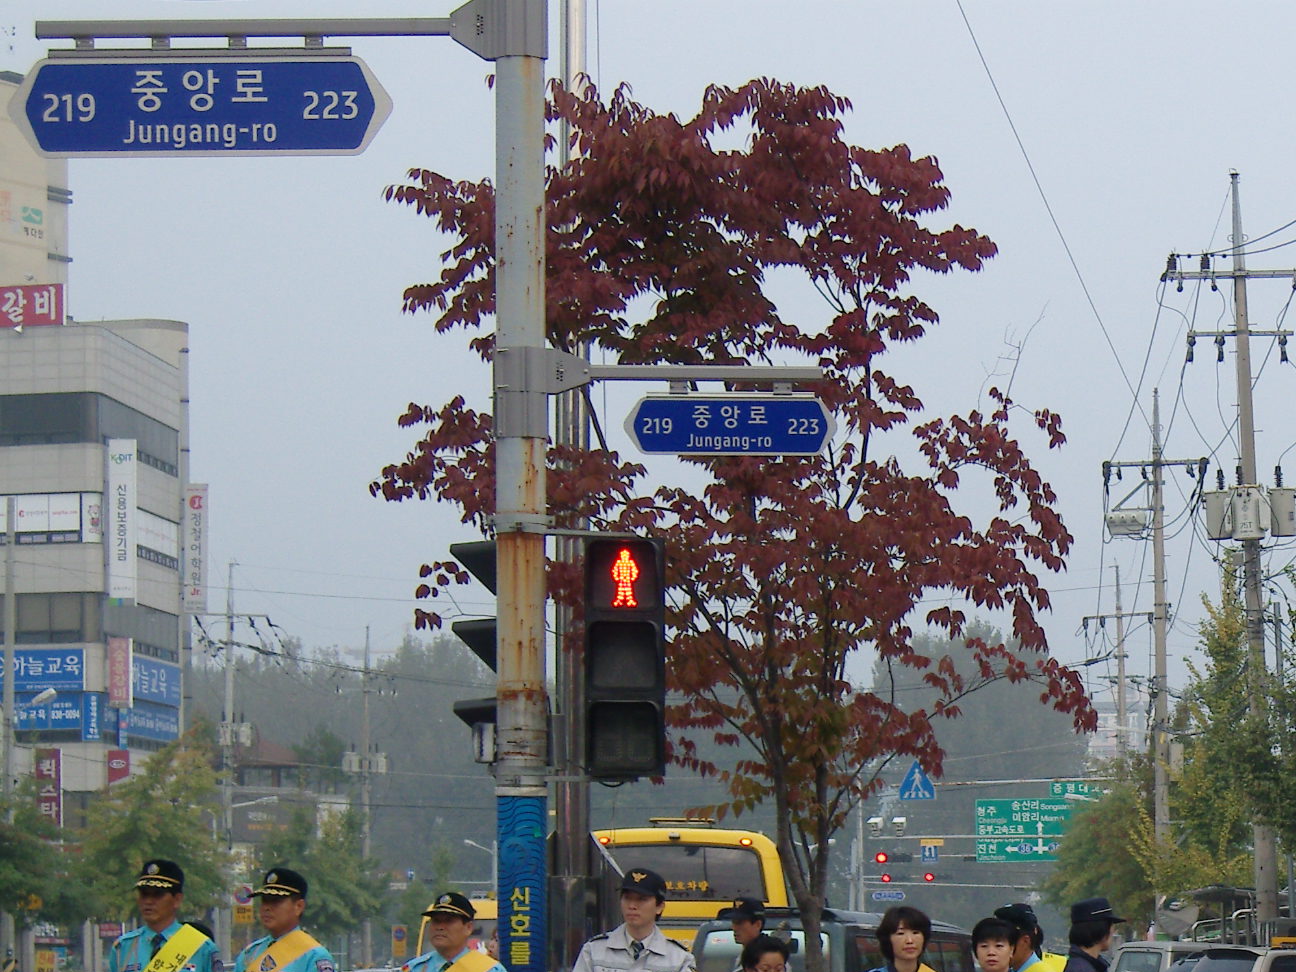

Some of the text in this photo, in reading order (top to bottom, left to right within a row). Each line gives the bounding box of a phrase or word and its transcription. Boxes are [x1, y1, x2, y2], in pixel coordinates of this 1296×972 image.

[131, 70, 269, 113] 중앙로
[302, 90, 360, 120] 223
[42, 93, 97, 124] 219
[123, 119, 279, 149] Jungang-ro
[642, 417, 674, 435] 219
[691, 404, 769, 429] 중앙로
[786, 418, 820, 436] 223
[686, 432, 773, 451] Jungang-ro
[116, 483, 127, 562] 신용보증기금
[978, 844, 997, 855] 진천
[509, 886, 532, 966] 신호를
